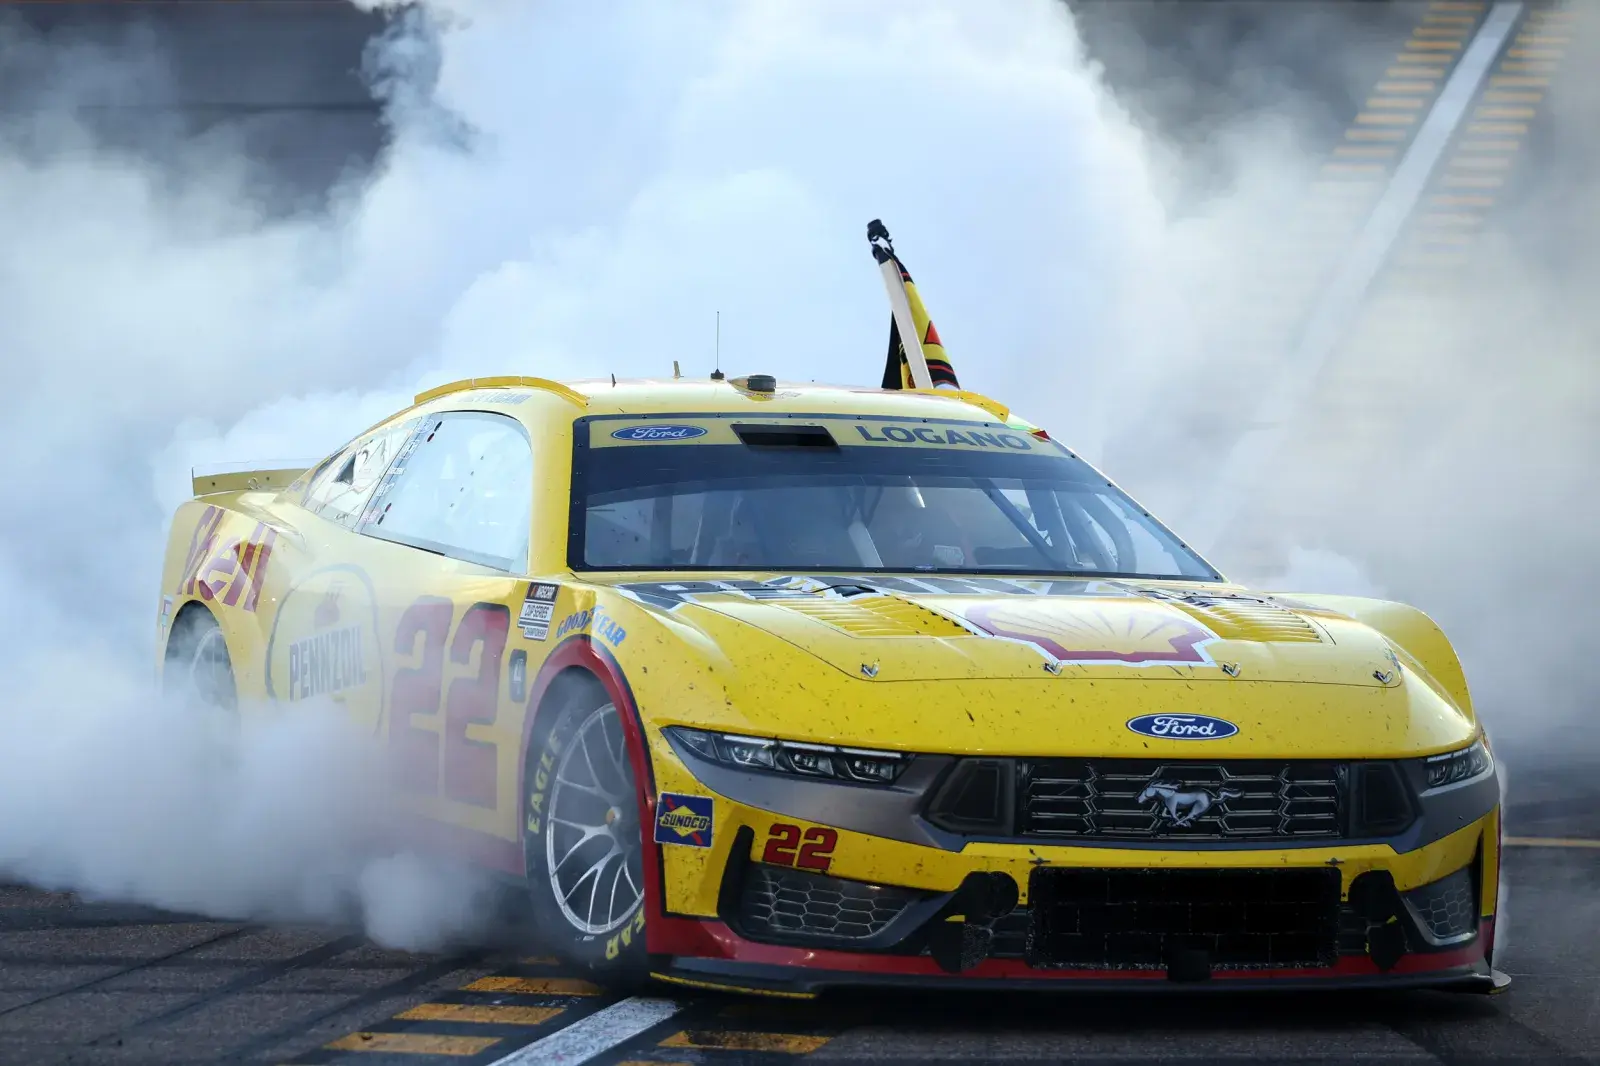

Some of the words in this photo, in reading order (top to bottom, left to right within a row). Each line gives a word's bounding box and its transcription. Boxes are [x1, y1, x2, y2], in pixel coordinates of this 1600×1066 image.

[632, 426, 688, 439] Ford
[855, 425, 1032, 450] LOGANO
[556, 604, 626, 647] GOODYEAR
[289, 624, 366, 701] PENNZOIL
[386, 594, 510, 811] 22
[1151, 716, 1217, 735] Ford
[527, 729, 561, 834] EAGLE
[661, 813, 709, 829] SUNOCO
[762, 823, 838, 870] 22
